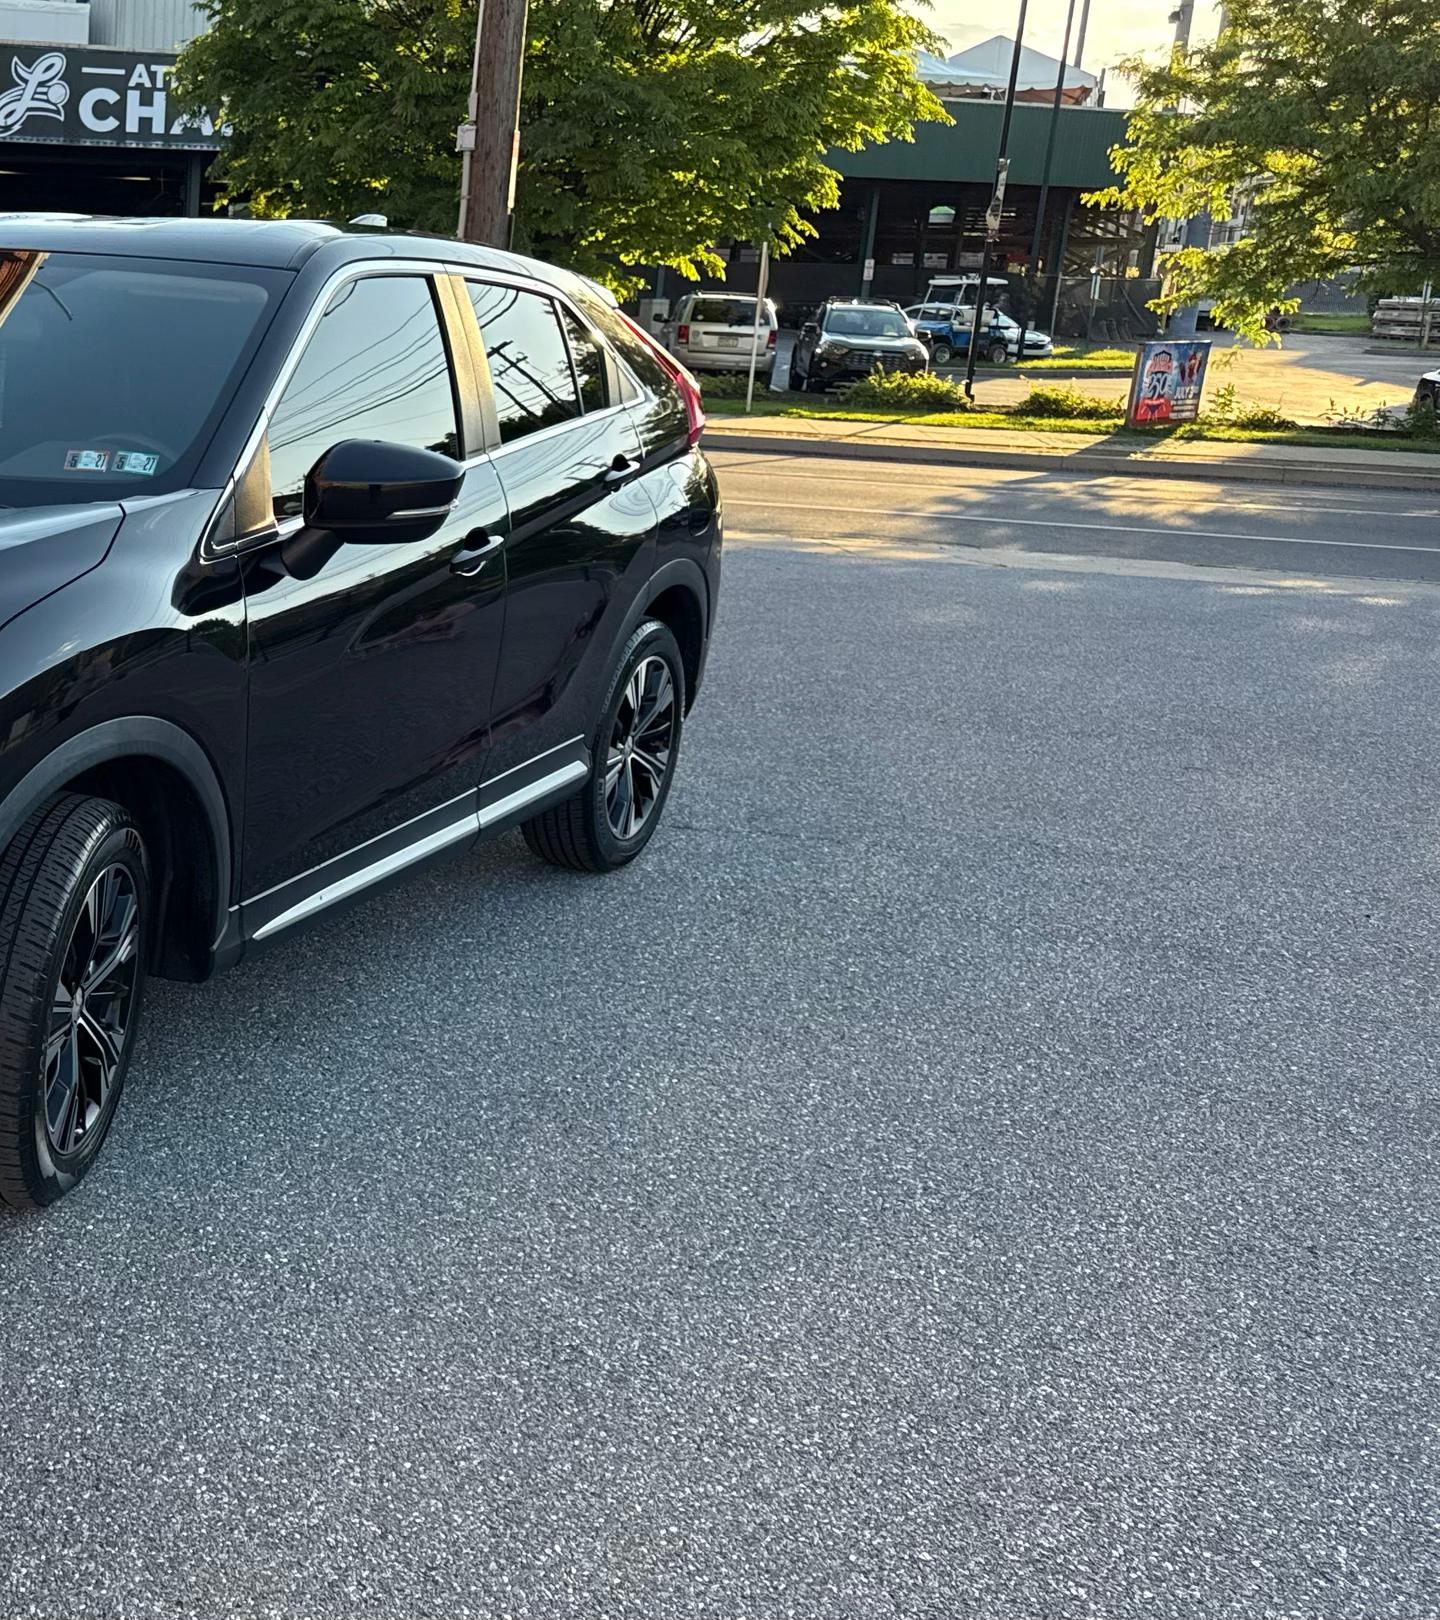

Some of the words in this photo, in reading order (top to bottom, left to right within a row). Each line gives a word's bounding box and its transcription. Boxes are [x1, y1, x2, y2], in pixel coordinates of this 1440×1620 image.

[78, 87, 233, 136] CHA
[70, 455, 78, 468] 5
[95, 454, 107, 468] 27
[116, 455, 128, 470] 5
[143, 456, 156, 471] 27
